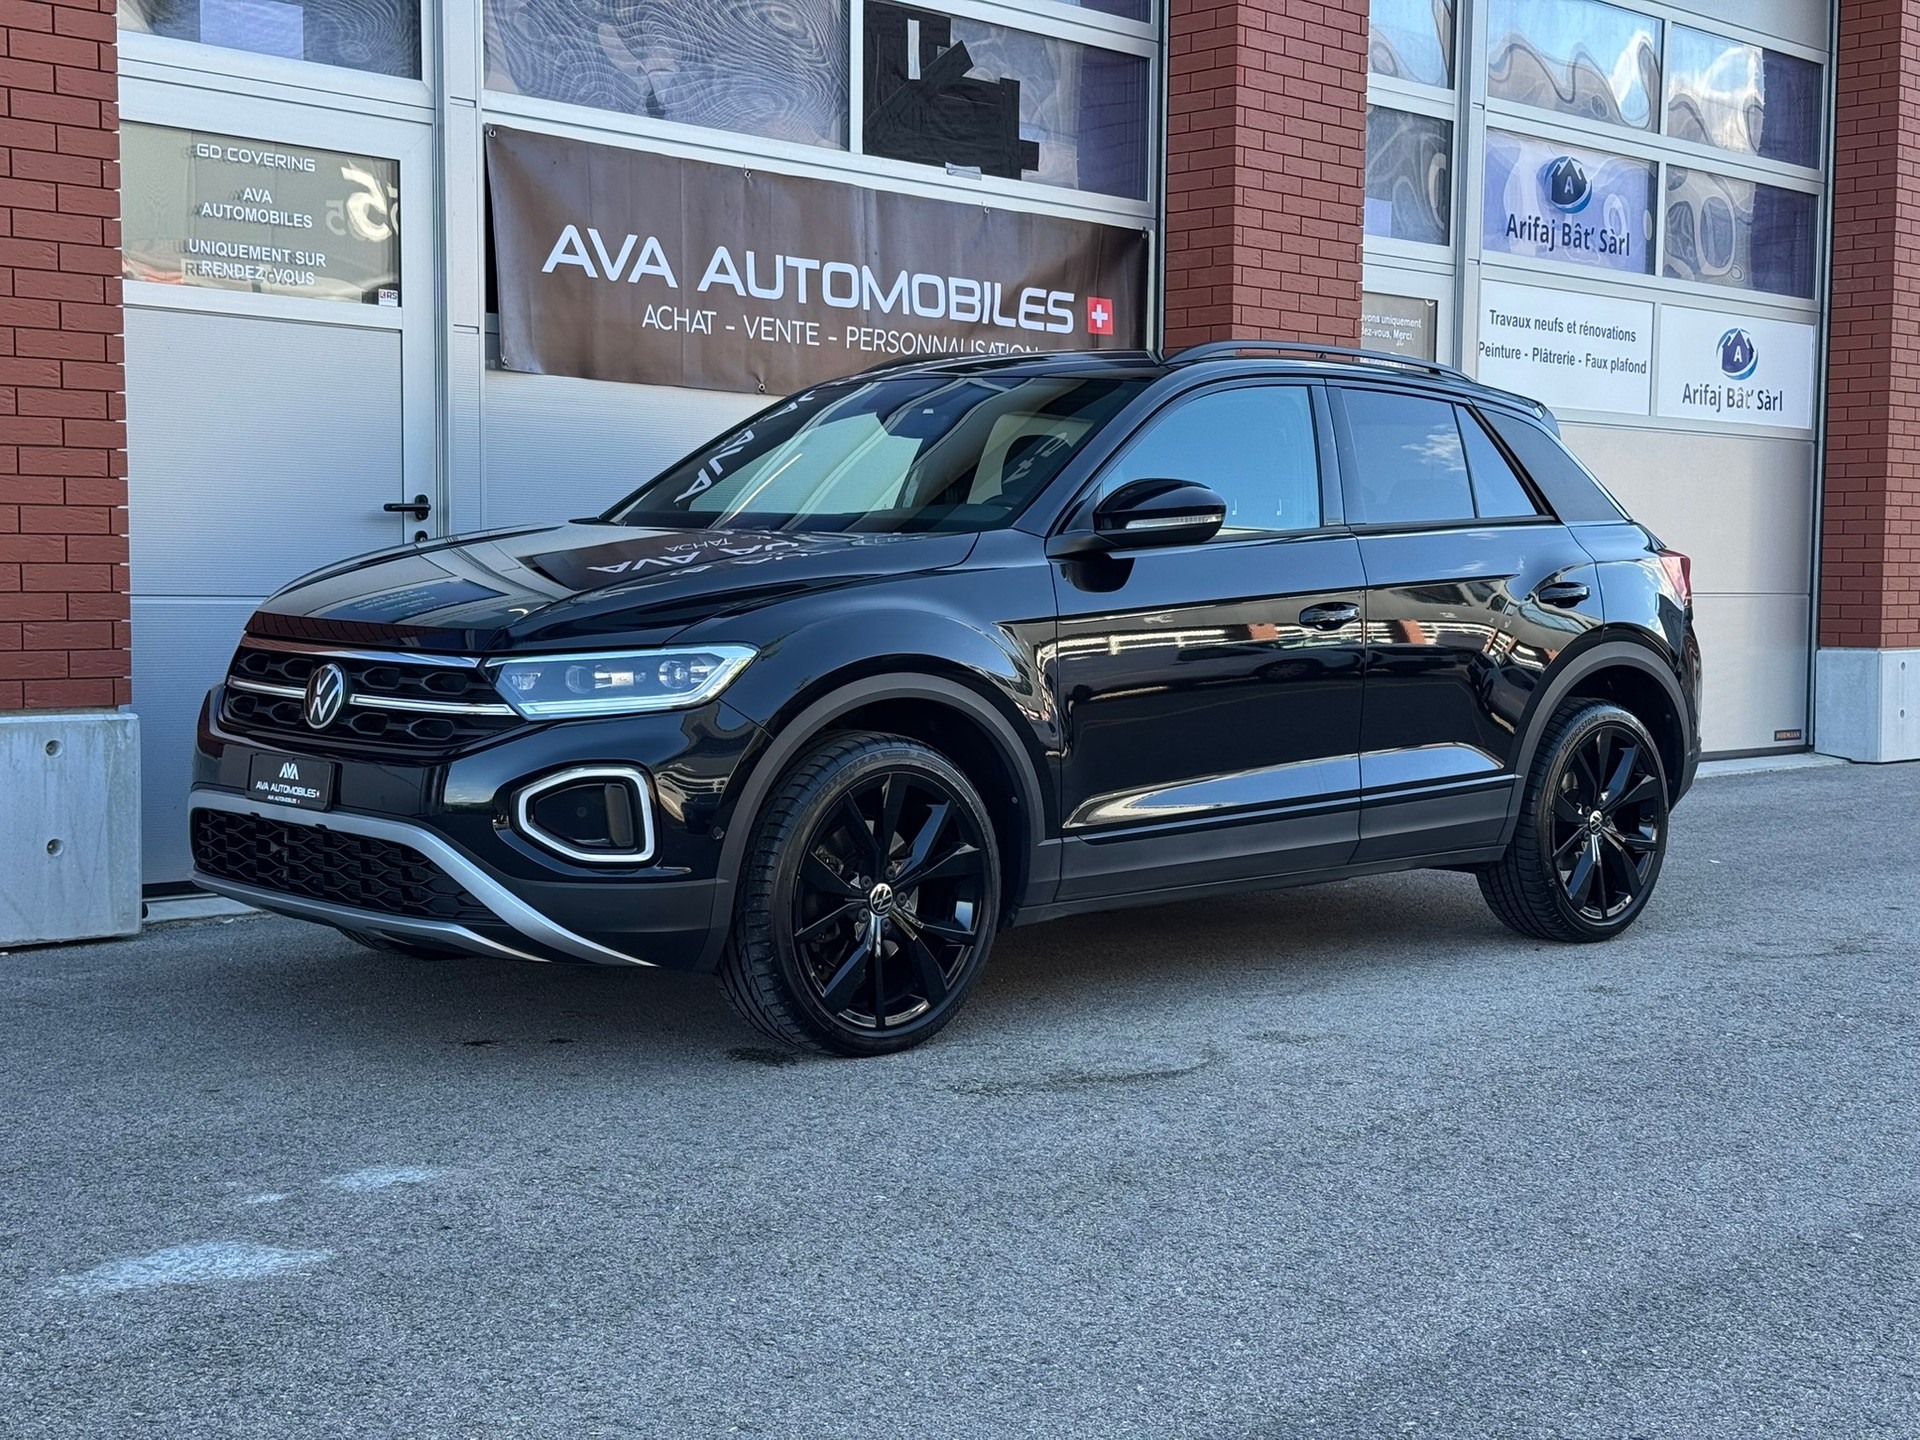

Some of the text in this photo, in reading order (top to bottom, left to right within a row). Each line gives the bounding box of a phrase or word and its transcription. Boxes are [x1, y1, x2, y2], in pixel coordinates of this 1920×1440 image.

[196, 143, 316, 172] GD COVERING
[243, 187, 273, 204] AVA
[201, 202, 313, 229] AUTOMOBILES
[1505, 213, 1556, 252] Arifaj
[1599, 228, 1631, 257] Sàrl
[188, 238, 327, 268] UNIQUEMENT SUR
[541, 223, 1075, 334] AVA AUTOMOBILES
[641, 303, 718, 336] ACHAT
[743, 314, 821, 347] VENTE
[1381, 315, 1422, 329] uniquement
[1489, 309, 1637, 343] Travaux neufs et rénovations
[1478, 341, 1521, 360] Peinture
[1532, 346, 1576, 366] Plâtrerie
[1585, 352, 1608, 370] Faux
[1610, 356, 1648, 375] plafond
[1682, 382, 1722, 413] Arifaj
[1757, 387, 1784, 412] Sàrl
[255, 780, 316, 798] AVA AUTOMOBILES
